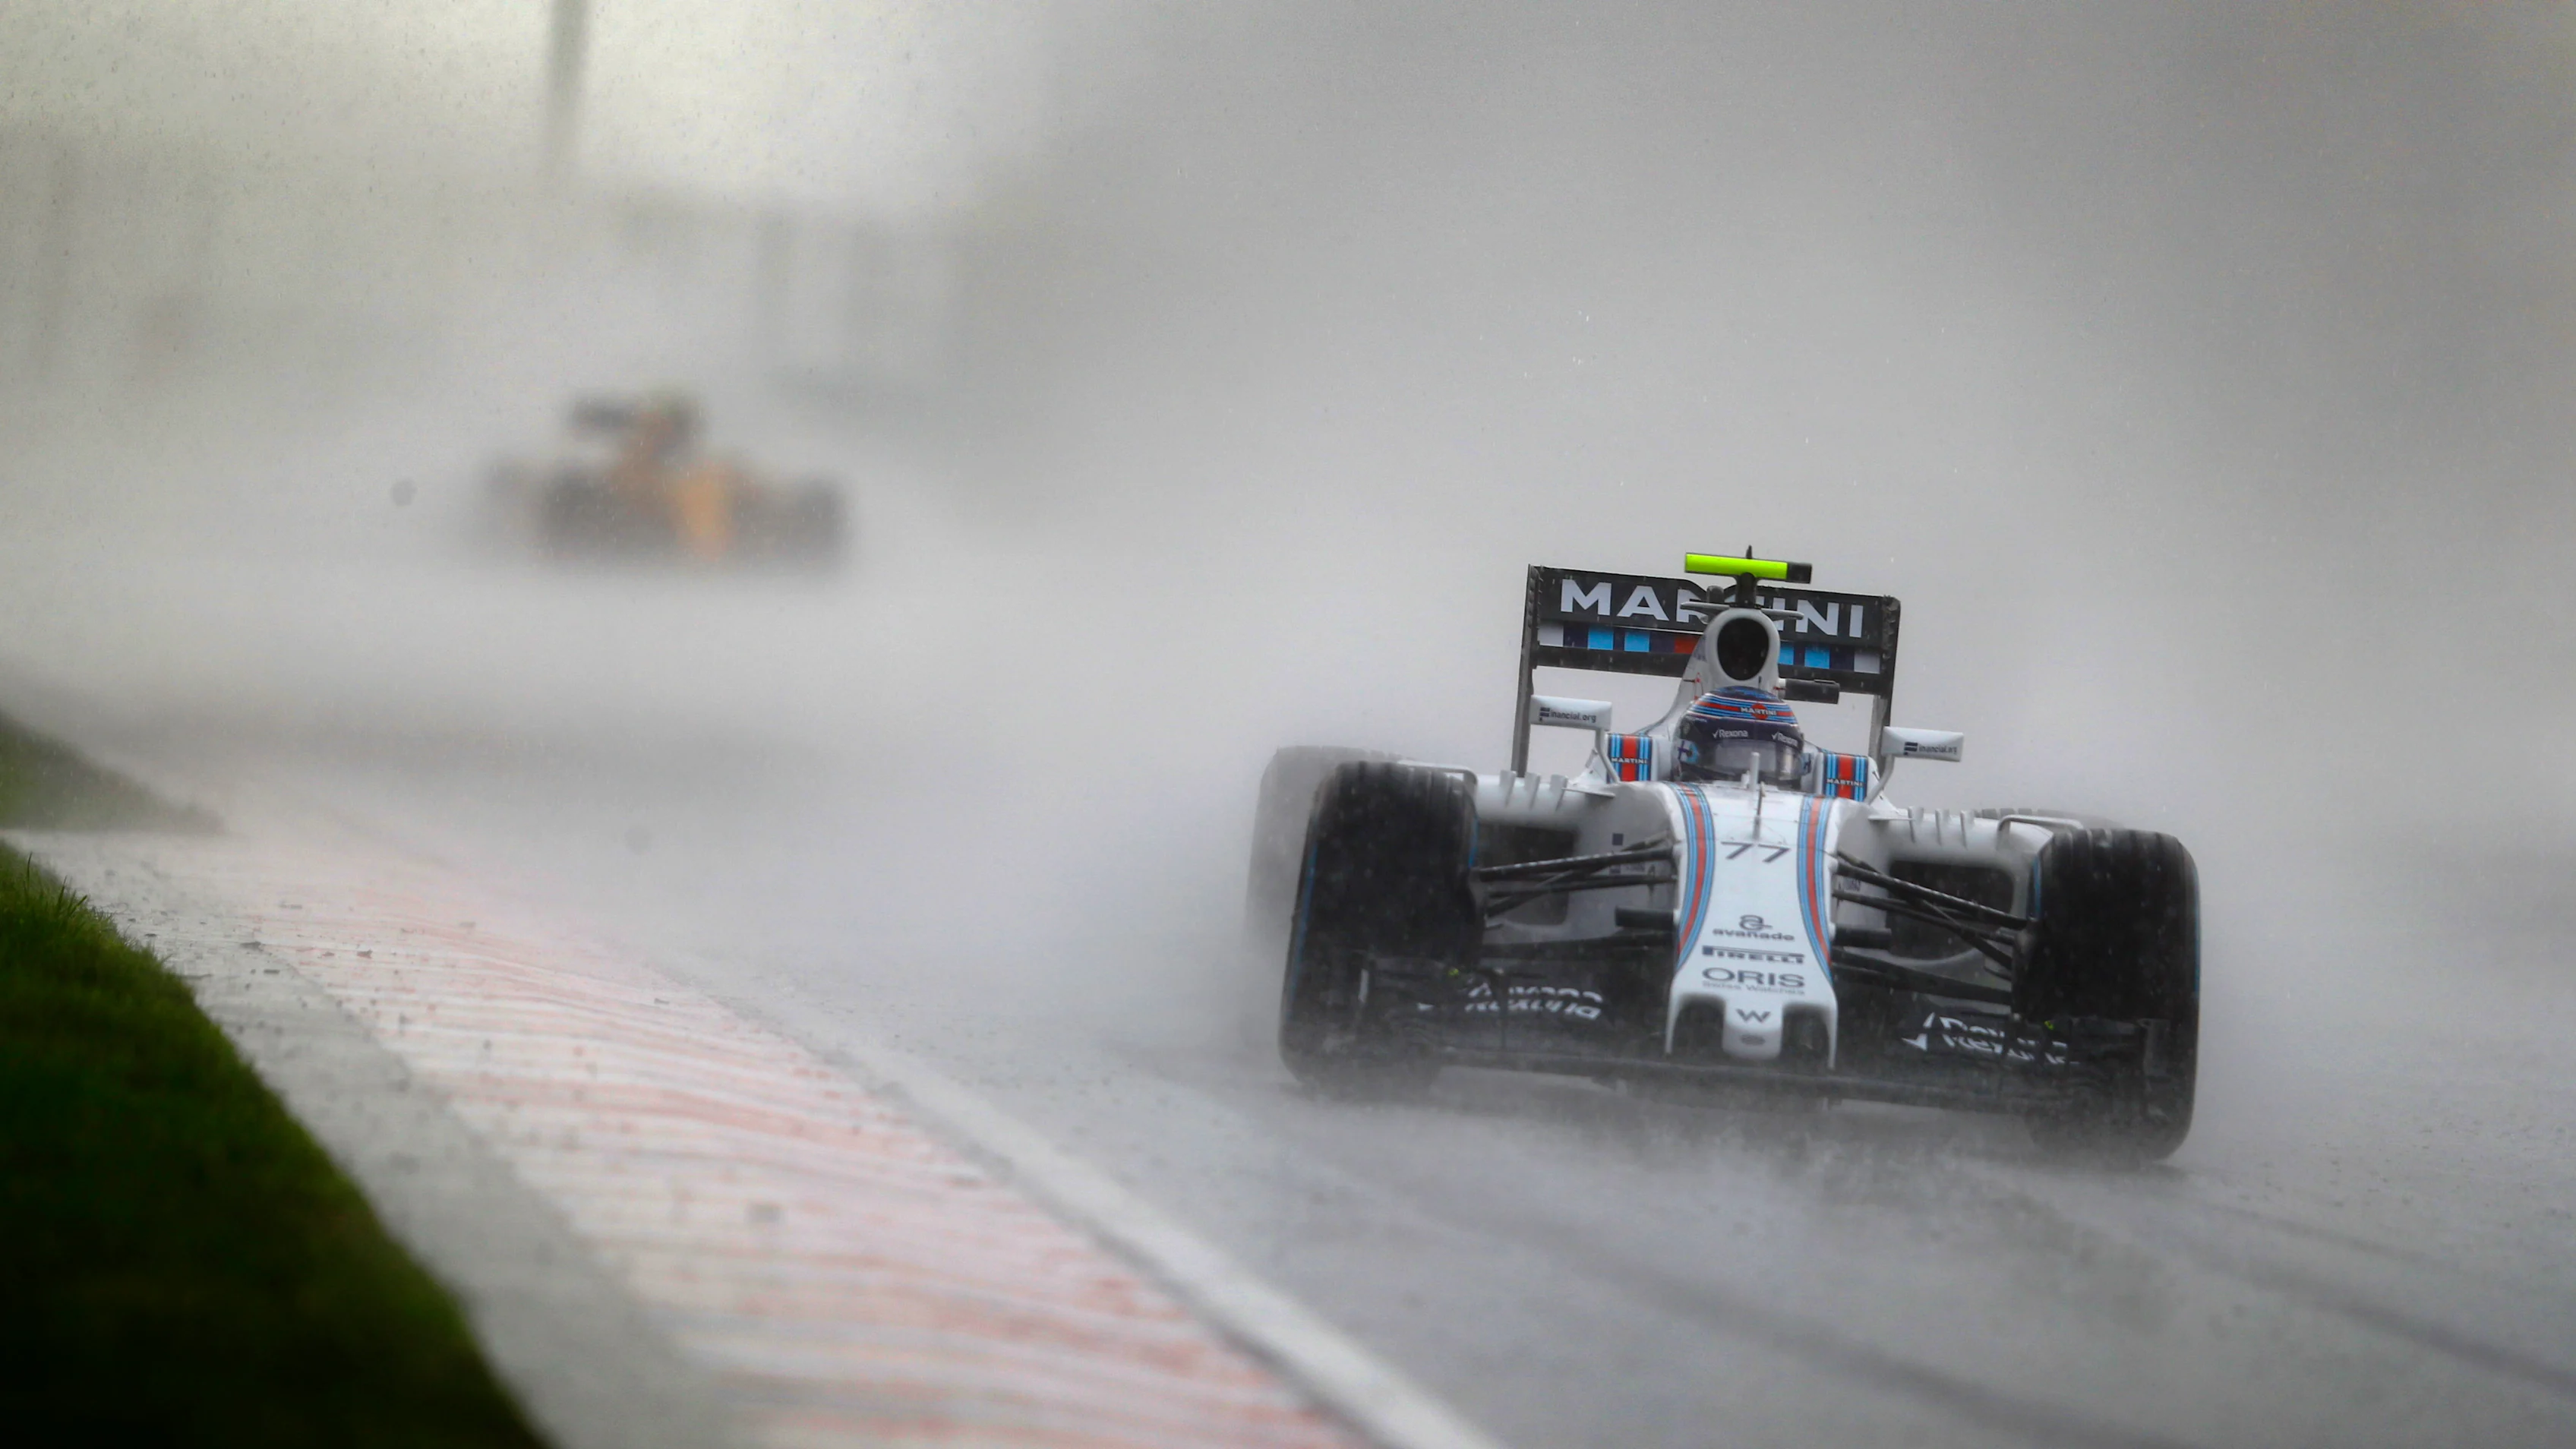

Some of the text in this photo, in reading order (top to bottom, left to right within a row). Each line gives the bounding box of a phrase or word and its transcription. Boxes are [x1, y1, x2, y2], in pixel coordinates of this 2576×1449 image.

[1560, 578, 1864, 638] MARINI
[1740, 706, 1778, 716] MARTINI
[1719, 728, 1749, 738] Rexona
[1611, 756, 1648, 765] MARTINI
[1826, 778, 1864, 788] MARTINI
[1720, 841, 1791, 863] 77
[1712, 928, 1795, 941] avanade
[1702, 945, 1805, 964] PIRELLI
[1702, 967, 1805, 988] ORIS
[1735, 1008, 1772, 1024] W
